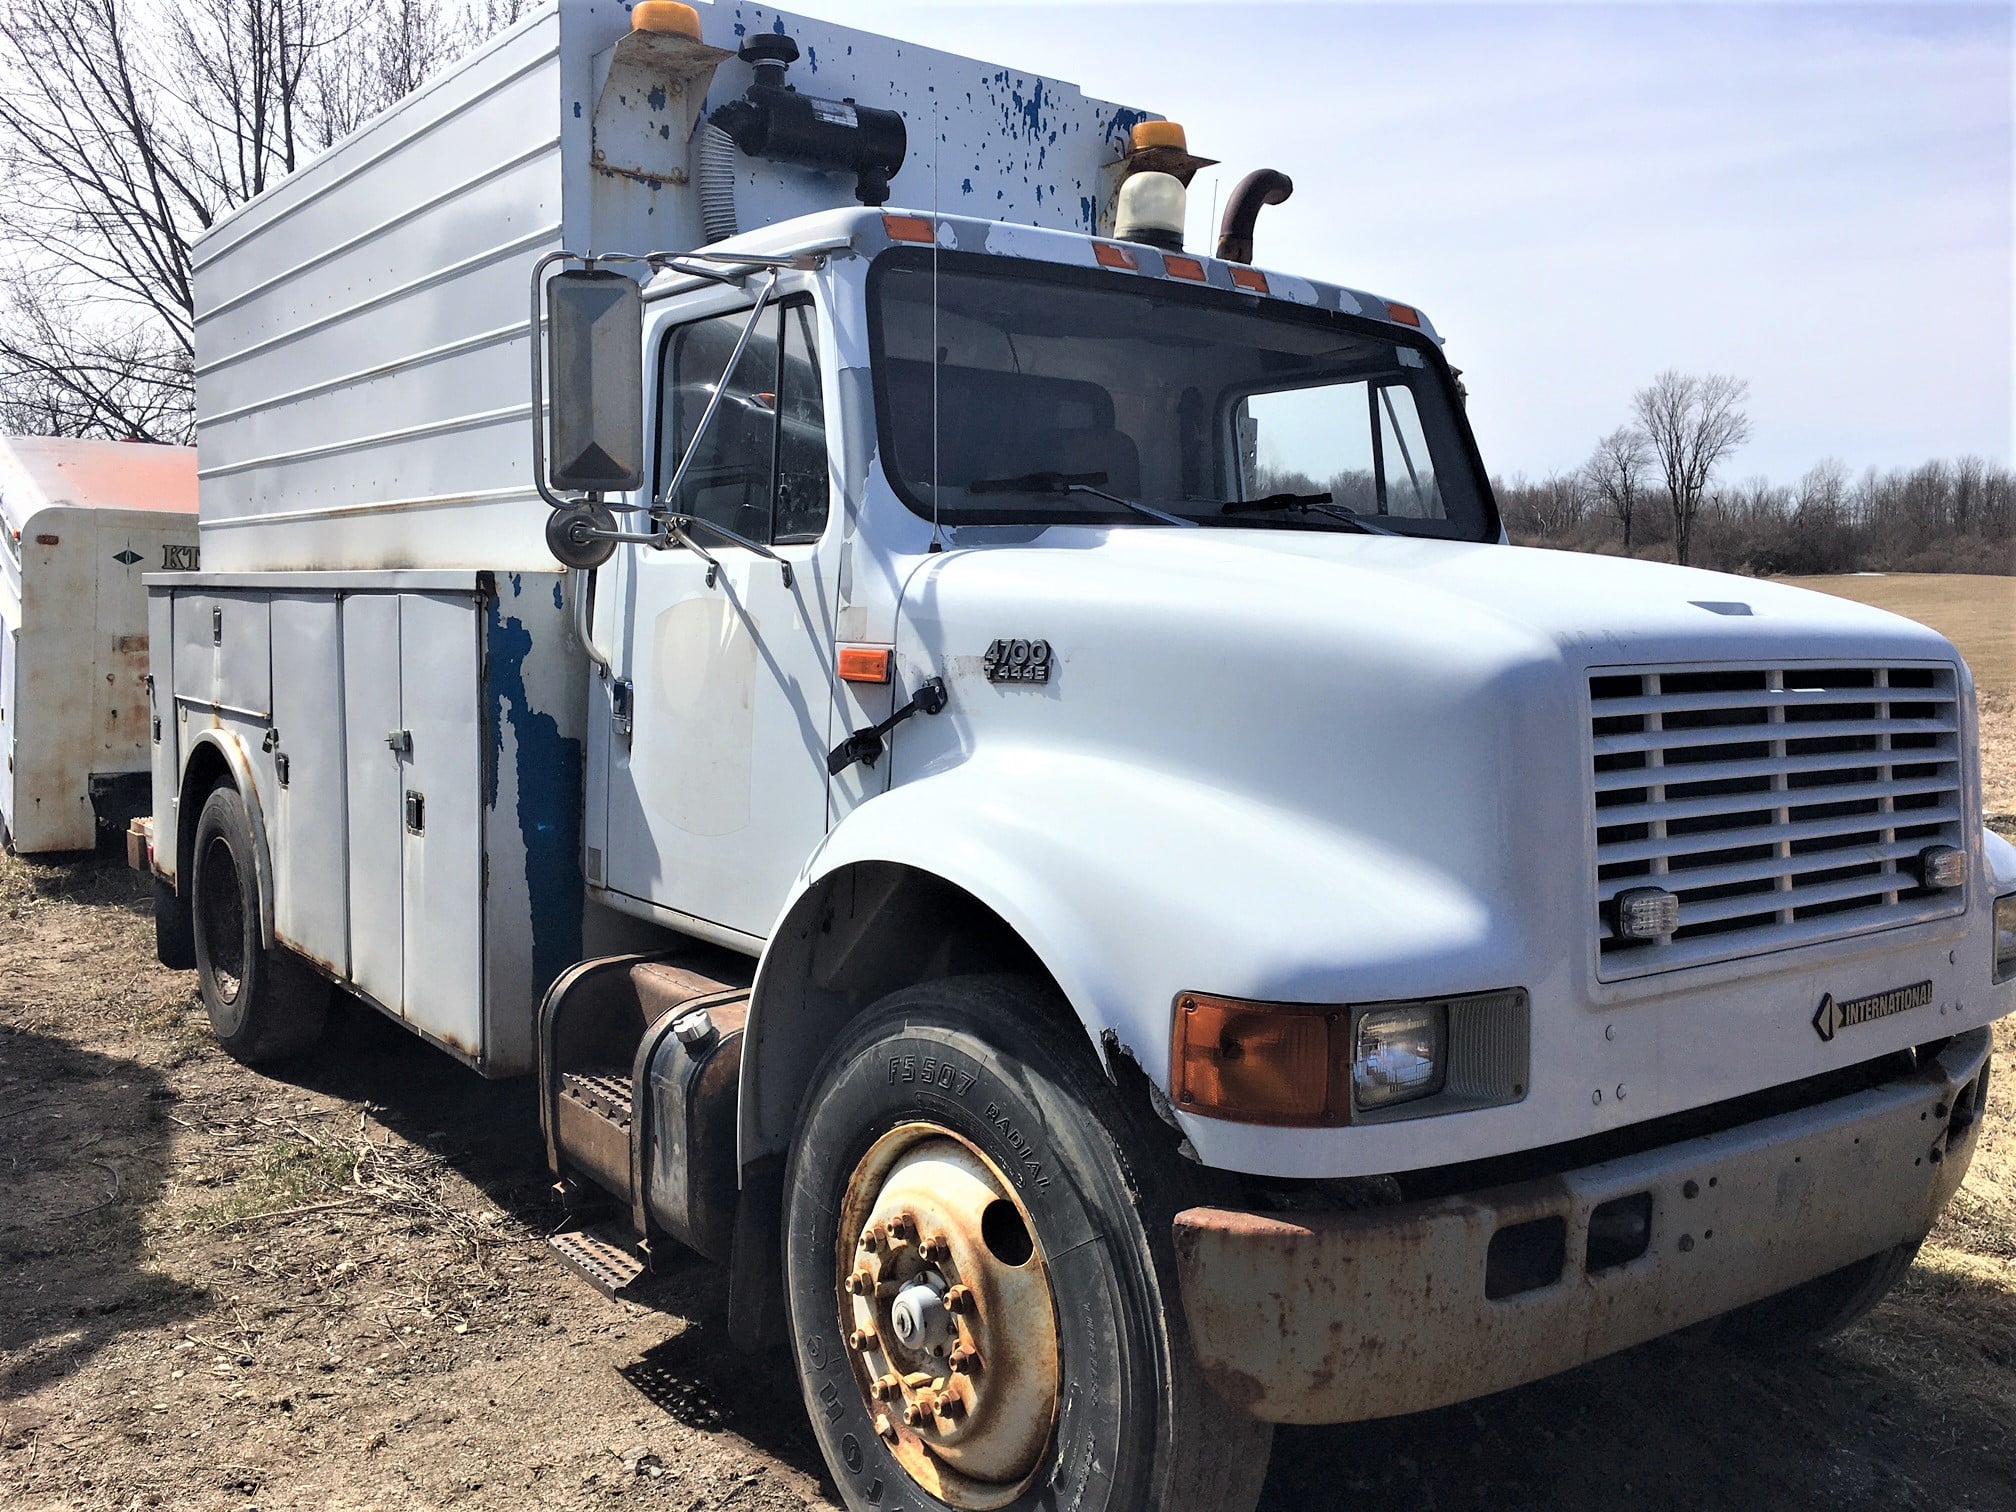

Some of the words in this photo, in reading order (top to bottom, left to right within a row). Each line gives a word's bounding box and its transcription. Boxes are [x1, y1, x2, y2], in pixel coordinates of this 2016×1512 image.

[985, 638, 1048, 665] 4700
[998, 664, 1047, 680] 444E
[1844, 982, 1933, 1027] INTERNATIONAL
[984, 1101, 1050, 1188] RADIAL
